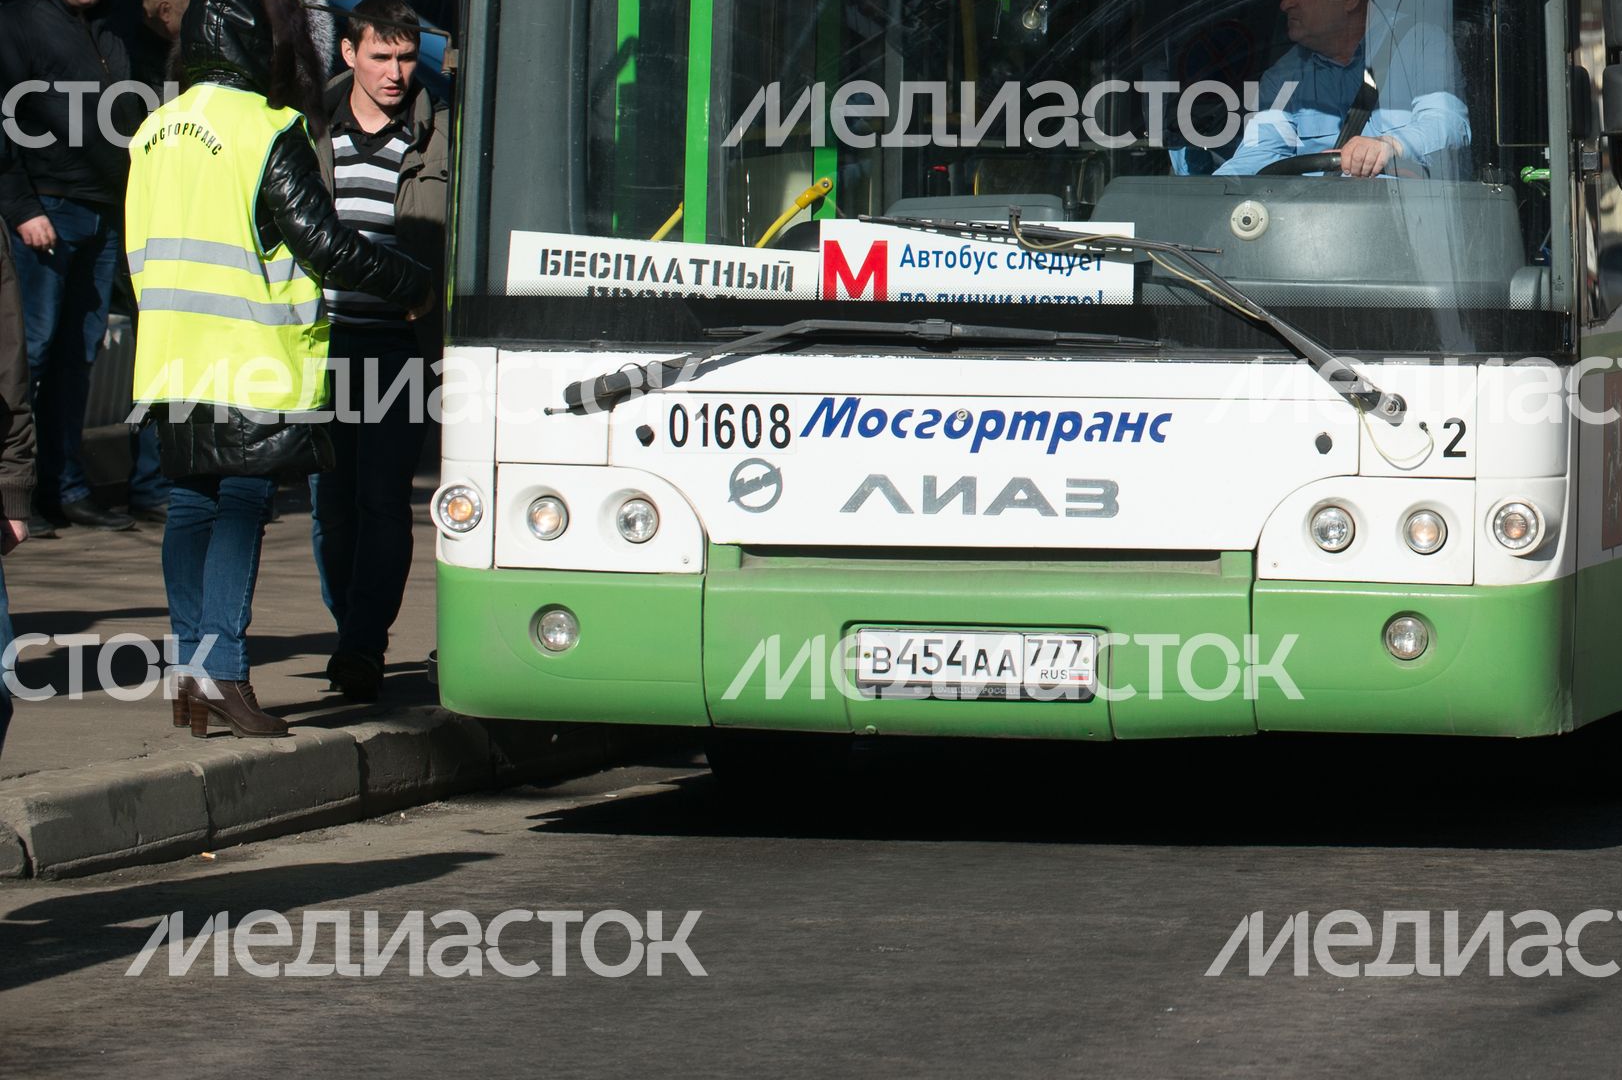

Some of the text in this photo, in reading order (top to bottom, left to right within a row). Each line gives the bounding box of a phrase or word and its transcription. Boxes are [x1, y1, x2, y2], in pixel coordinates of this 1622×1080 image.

[144, 123, 222, 156] МОСГОРТРАНС
[539, 248, 795, 292] БЕСПЛАТНЫЙ
[823, 240, 888, 301] М
[900, 243, 1105, 277] Автобус следует
[669, 403, 791, 449] 01608
[800, 397, 1172, 454] Мосгортранс
[1443, 417, 1467, 457] 2
[839, 473, 1120, 518] ЛИАЗ
[1027, 639, 1083, 668] 777
[1040, 669, 1068, 680] RUS
